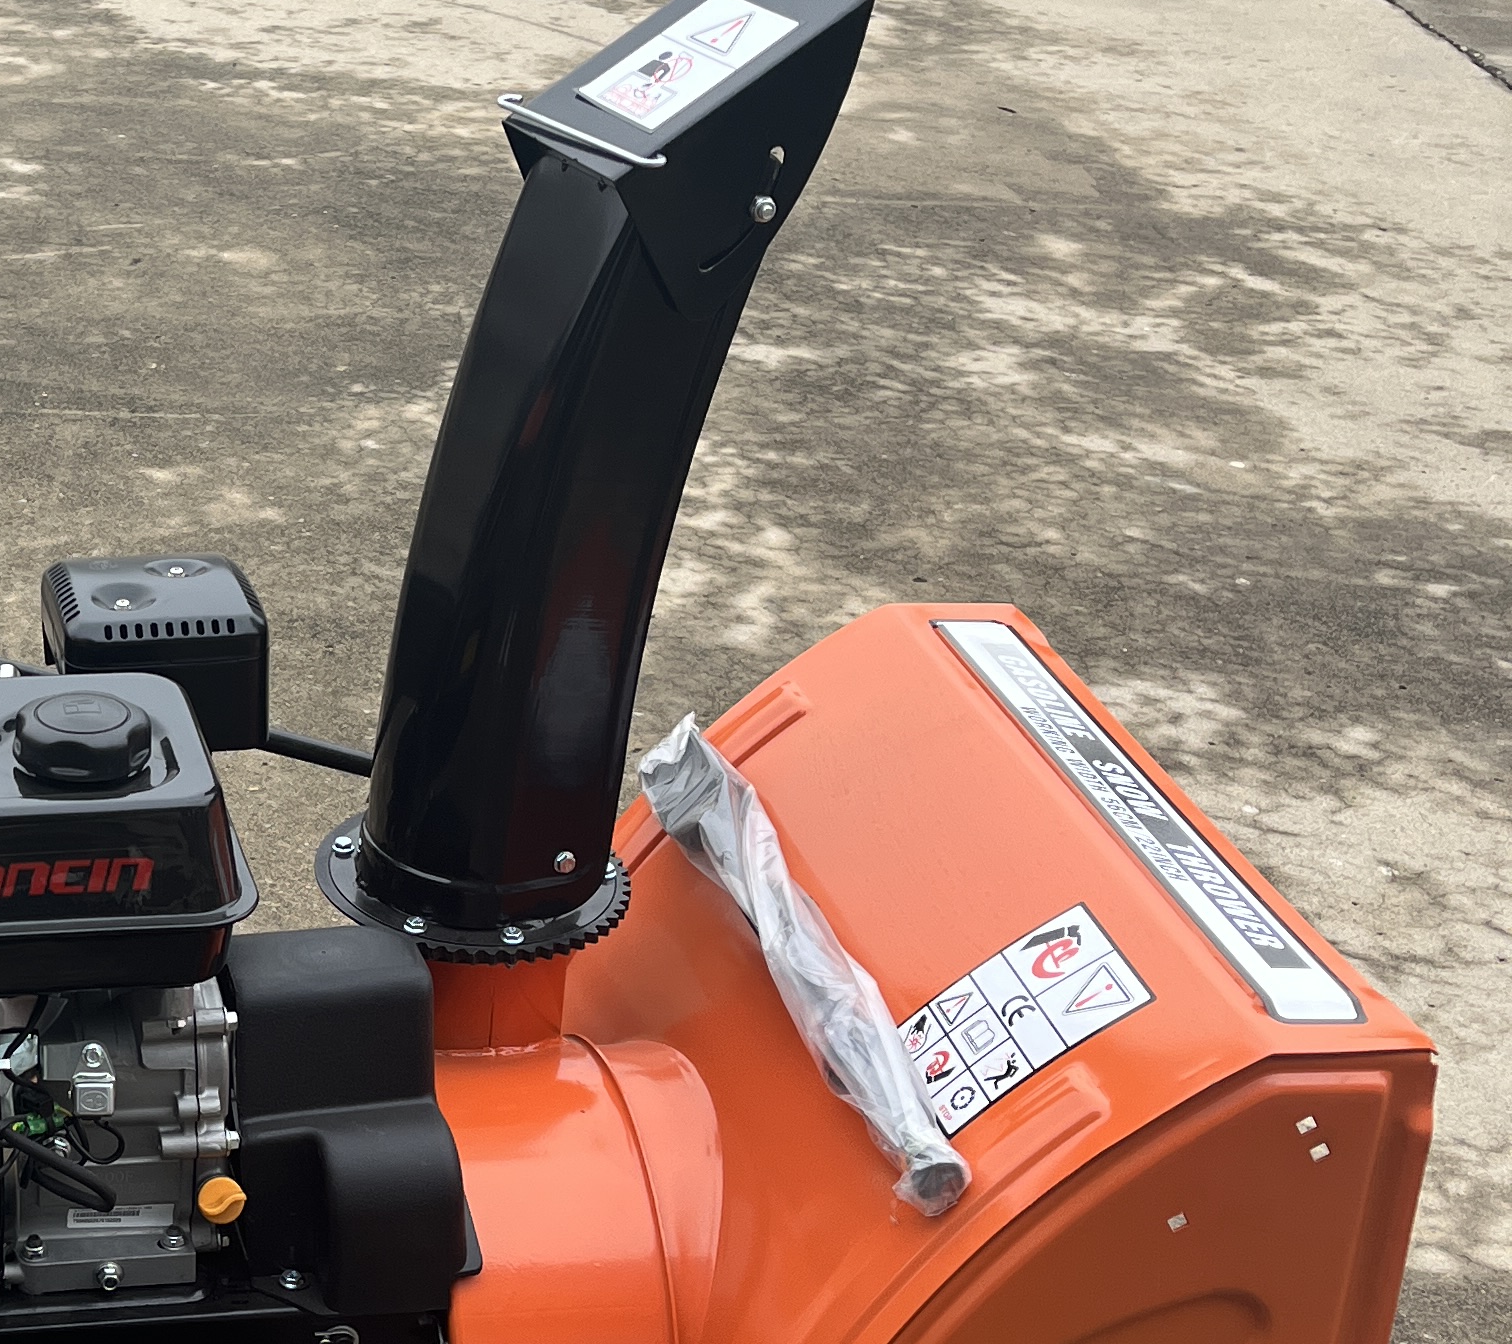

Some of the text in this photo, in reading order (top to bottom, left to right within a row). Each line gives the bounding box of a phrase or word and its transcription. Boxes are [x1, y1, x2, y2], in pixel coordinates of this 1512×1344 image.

[1019, 706, 1076, 754] WORKING
[1065, 758, 1110, 793] WIDTH
[998, 655, 1285, 950] GASOLINE SNOW THROWER
[938, 1104, 953, 1121] STOP
